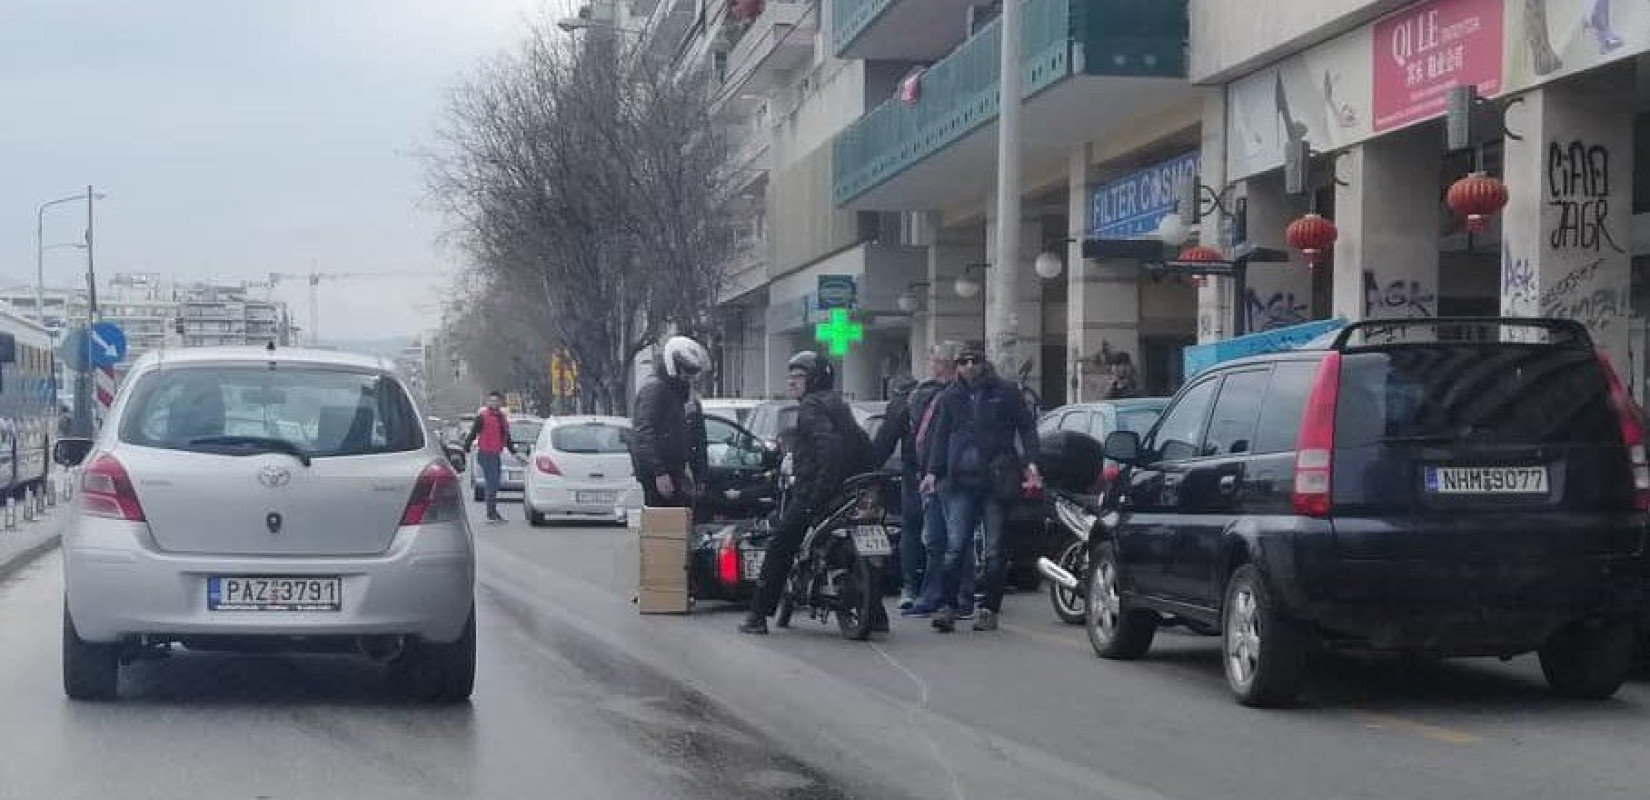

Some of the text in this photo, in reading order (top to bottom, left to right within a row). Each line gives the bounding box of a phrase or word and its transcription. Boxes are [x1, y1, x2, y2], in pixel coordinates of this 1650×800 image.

[1393, 21, 1412, 67] QI
[1418, 10, 1439, 52] LE
[1093, 180, 1137, 226] FILTER
